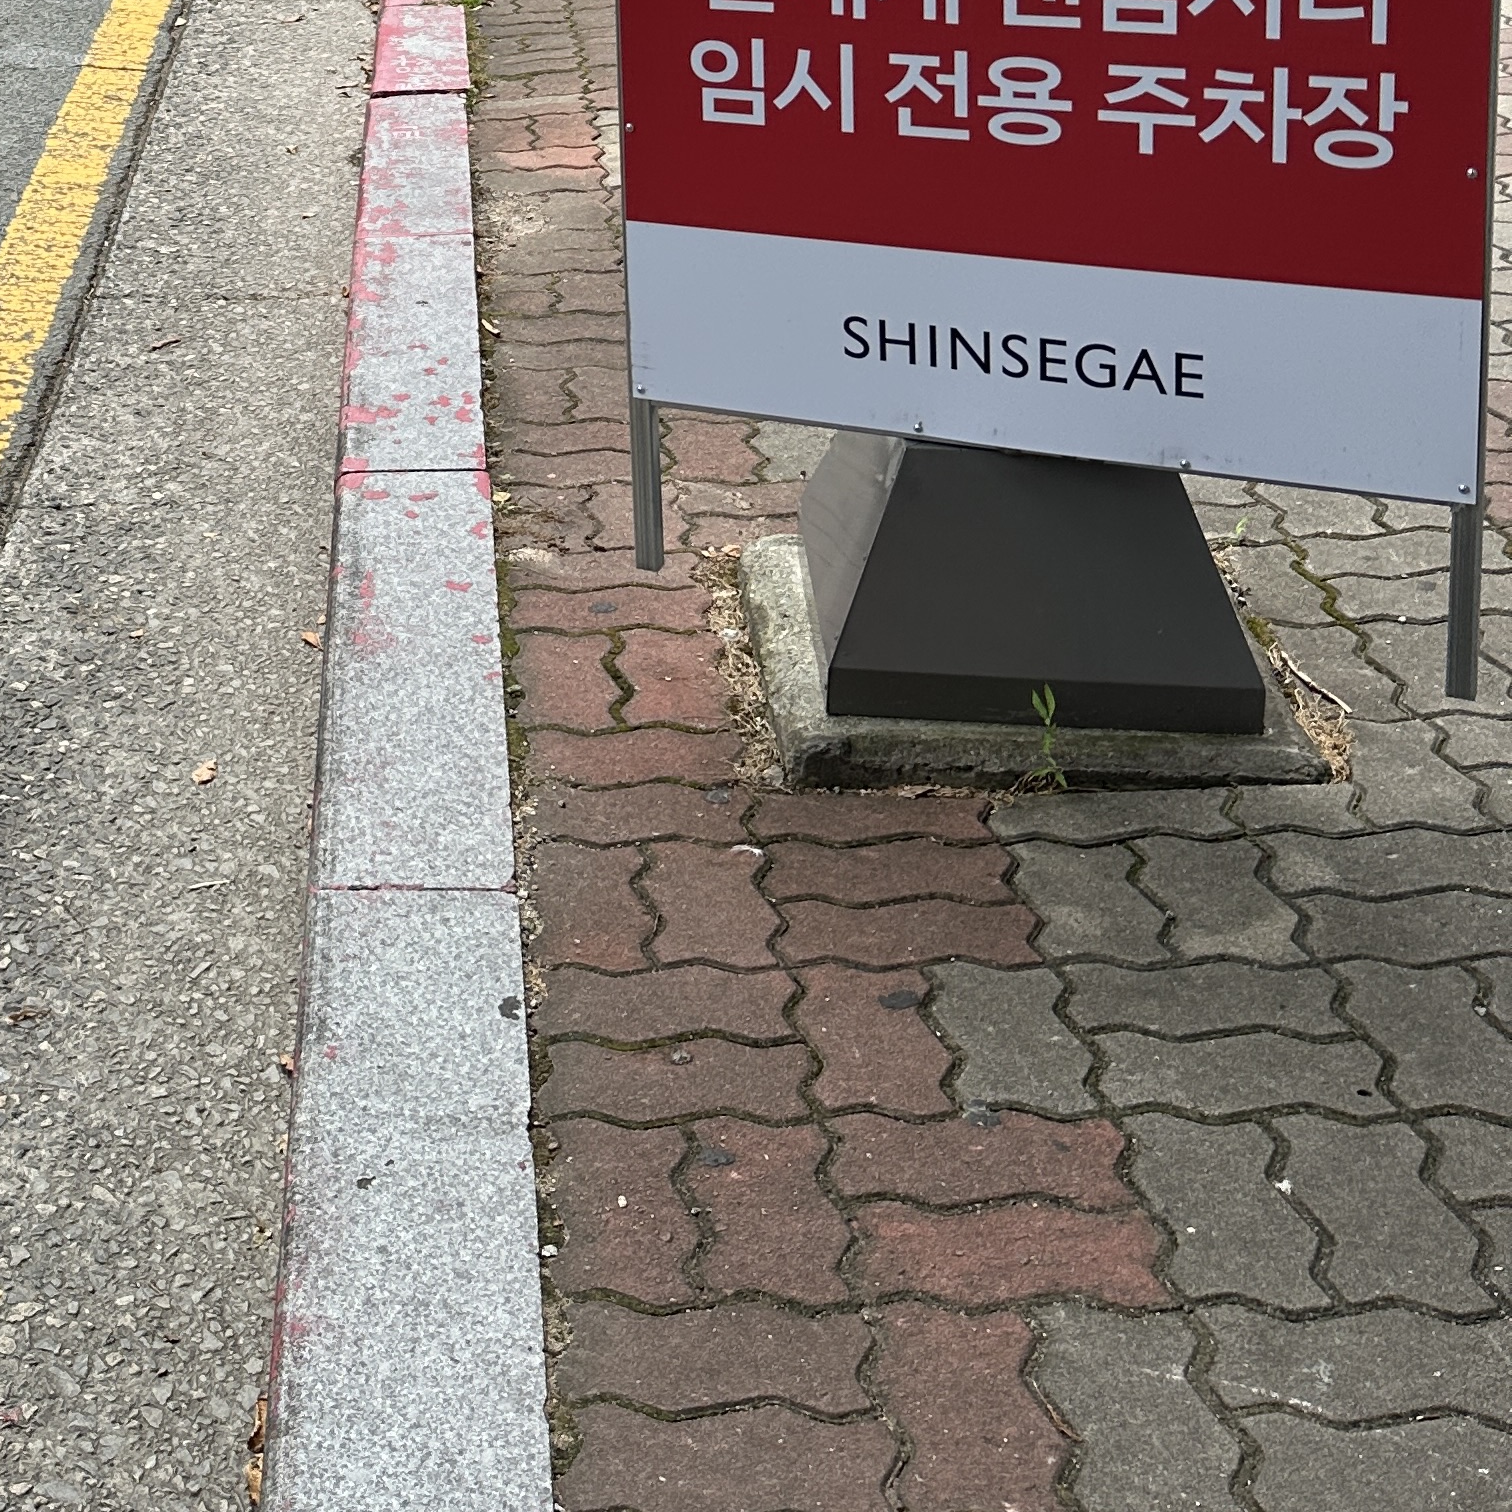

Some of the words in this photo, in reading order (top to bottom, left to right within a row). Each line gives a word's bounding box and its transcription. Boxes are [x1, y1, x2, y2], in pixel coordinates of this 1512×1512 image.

[690, 37, 855, 134] 임시
[884, 49, 1074, 147] 전용
[1096, 62, 1410, 170] 주차장
[843, 315, 1204, 399] SHINSEGAE
